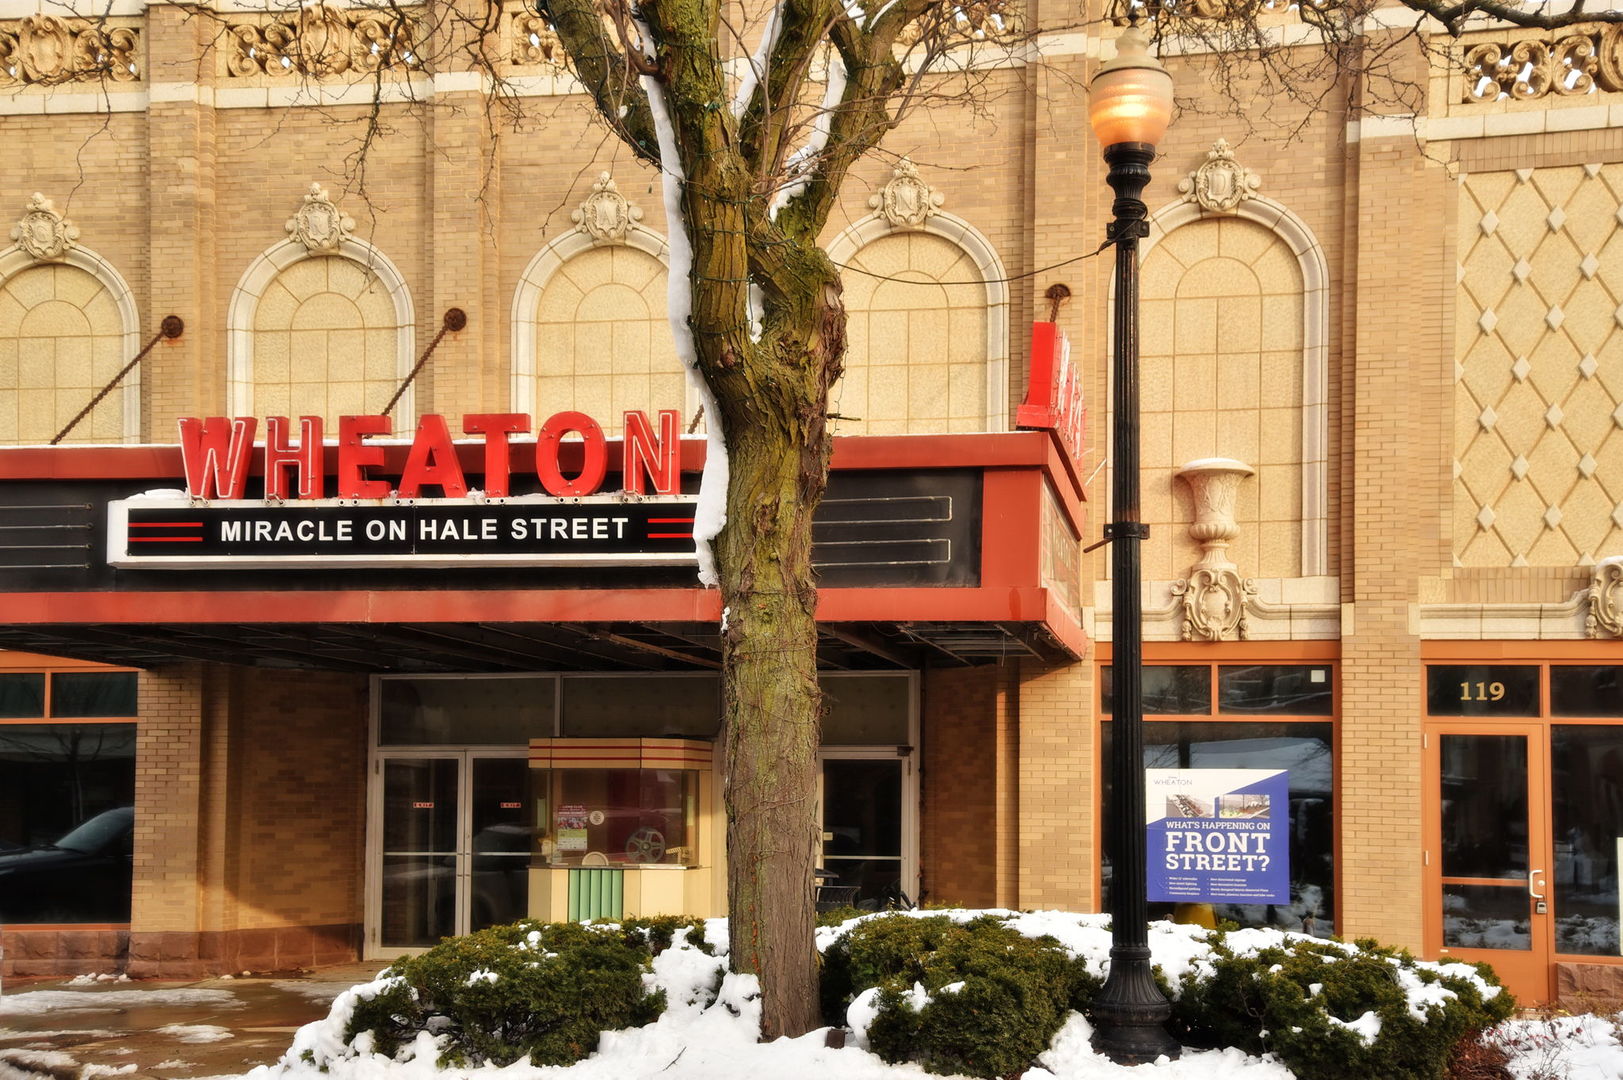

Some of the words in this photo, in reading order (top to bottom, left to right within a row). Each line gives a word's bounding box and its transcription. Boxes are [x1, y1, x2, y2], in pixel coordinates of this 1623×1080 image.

[177, 409, 680, 499] WHEATON
[221, 520, 353, 542] MIRACLE
[366, 519, 406, 541] ON
[420, 518, 498, 540] HALE
[511, 517, 629, 539] STREET
[1460, 681, 1505, 701] 119
[1166, 821, 1200, 829] WHAT'S
[1202, 822, 1255, 830] HAPPENING
[1257, 822, 1270, 830] ON
[1165, 832, 1271, 853] FRONT
[1165, 853, 1271, 871] STREET?
